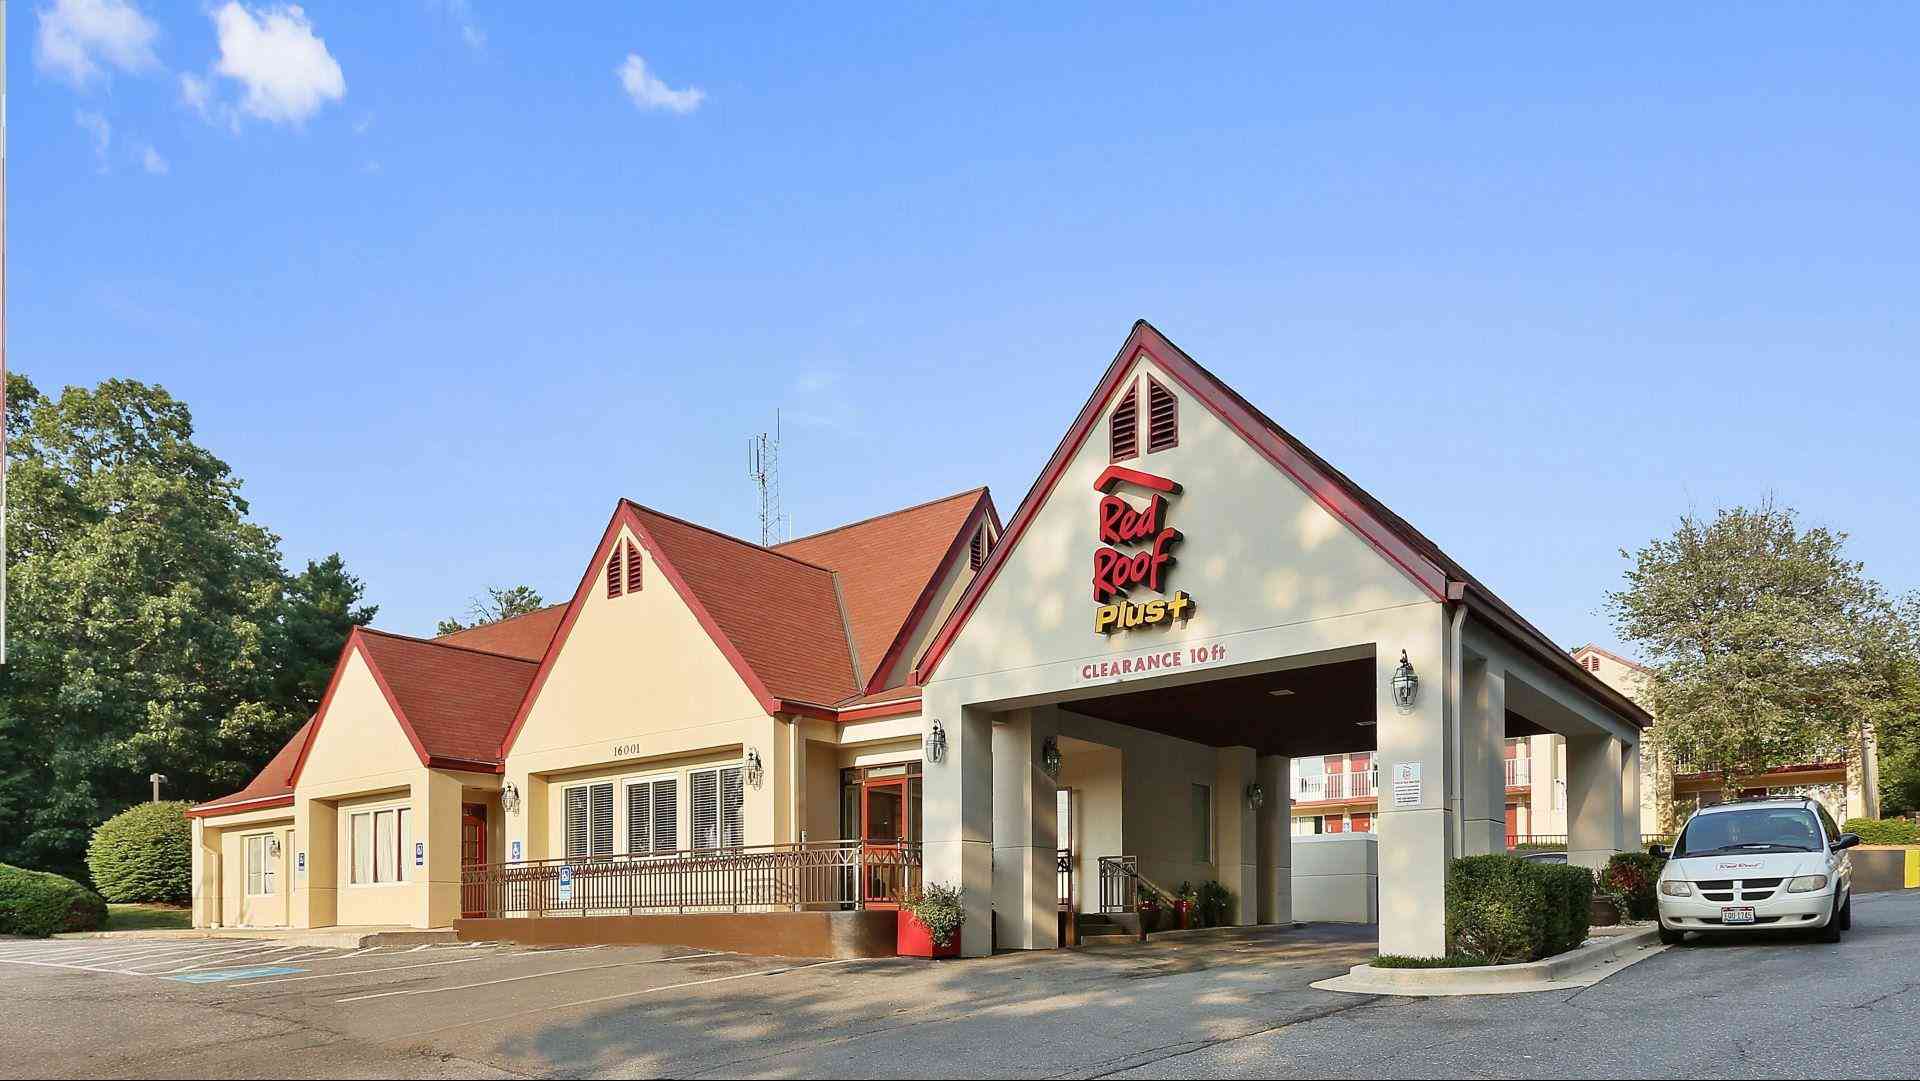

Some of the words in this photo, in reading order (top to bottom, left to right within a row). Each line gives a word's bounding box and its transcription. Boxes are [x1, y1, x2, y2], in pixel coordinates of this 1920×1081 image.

[1099, 494, 1166, 545] Red
[1093, 528, 1181, 603] Roof
[1082, 651, 1182, 680] CLEARANCE
[613, 743, 641, 757] 16001
